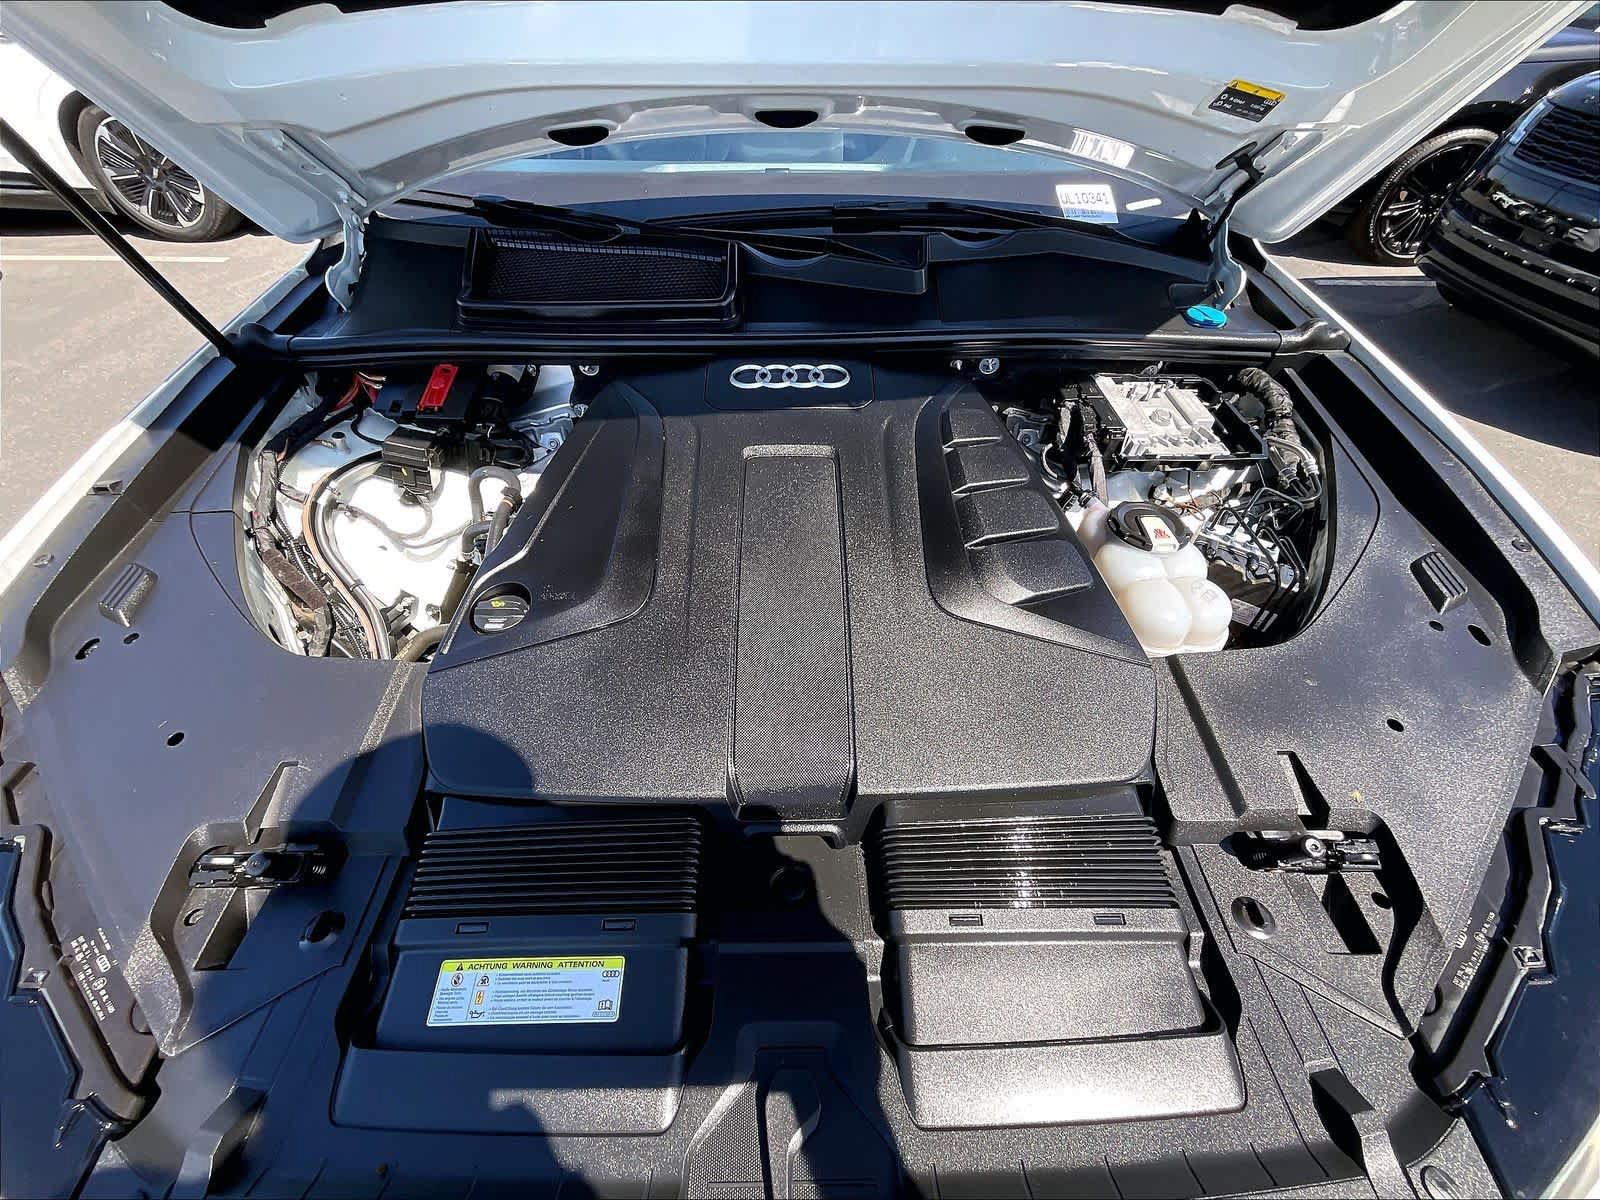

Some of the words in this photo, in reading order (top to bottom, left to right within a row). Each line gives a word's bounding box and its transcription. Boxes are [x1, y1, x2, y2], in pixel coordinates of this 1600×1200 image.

[1060, 191, 1109, 205] UL10341
[467, 962, 508, 970] ACHTUNG
[512, 961, 554, 969] WARNING
[557, 960, 605, 968] ATTENTION
